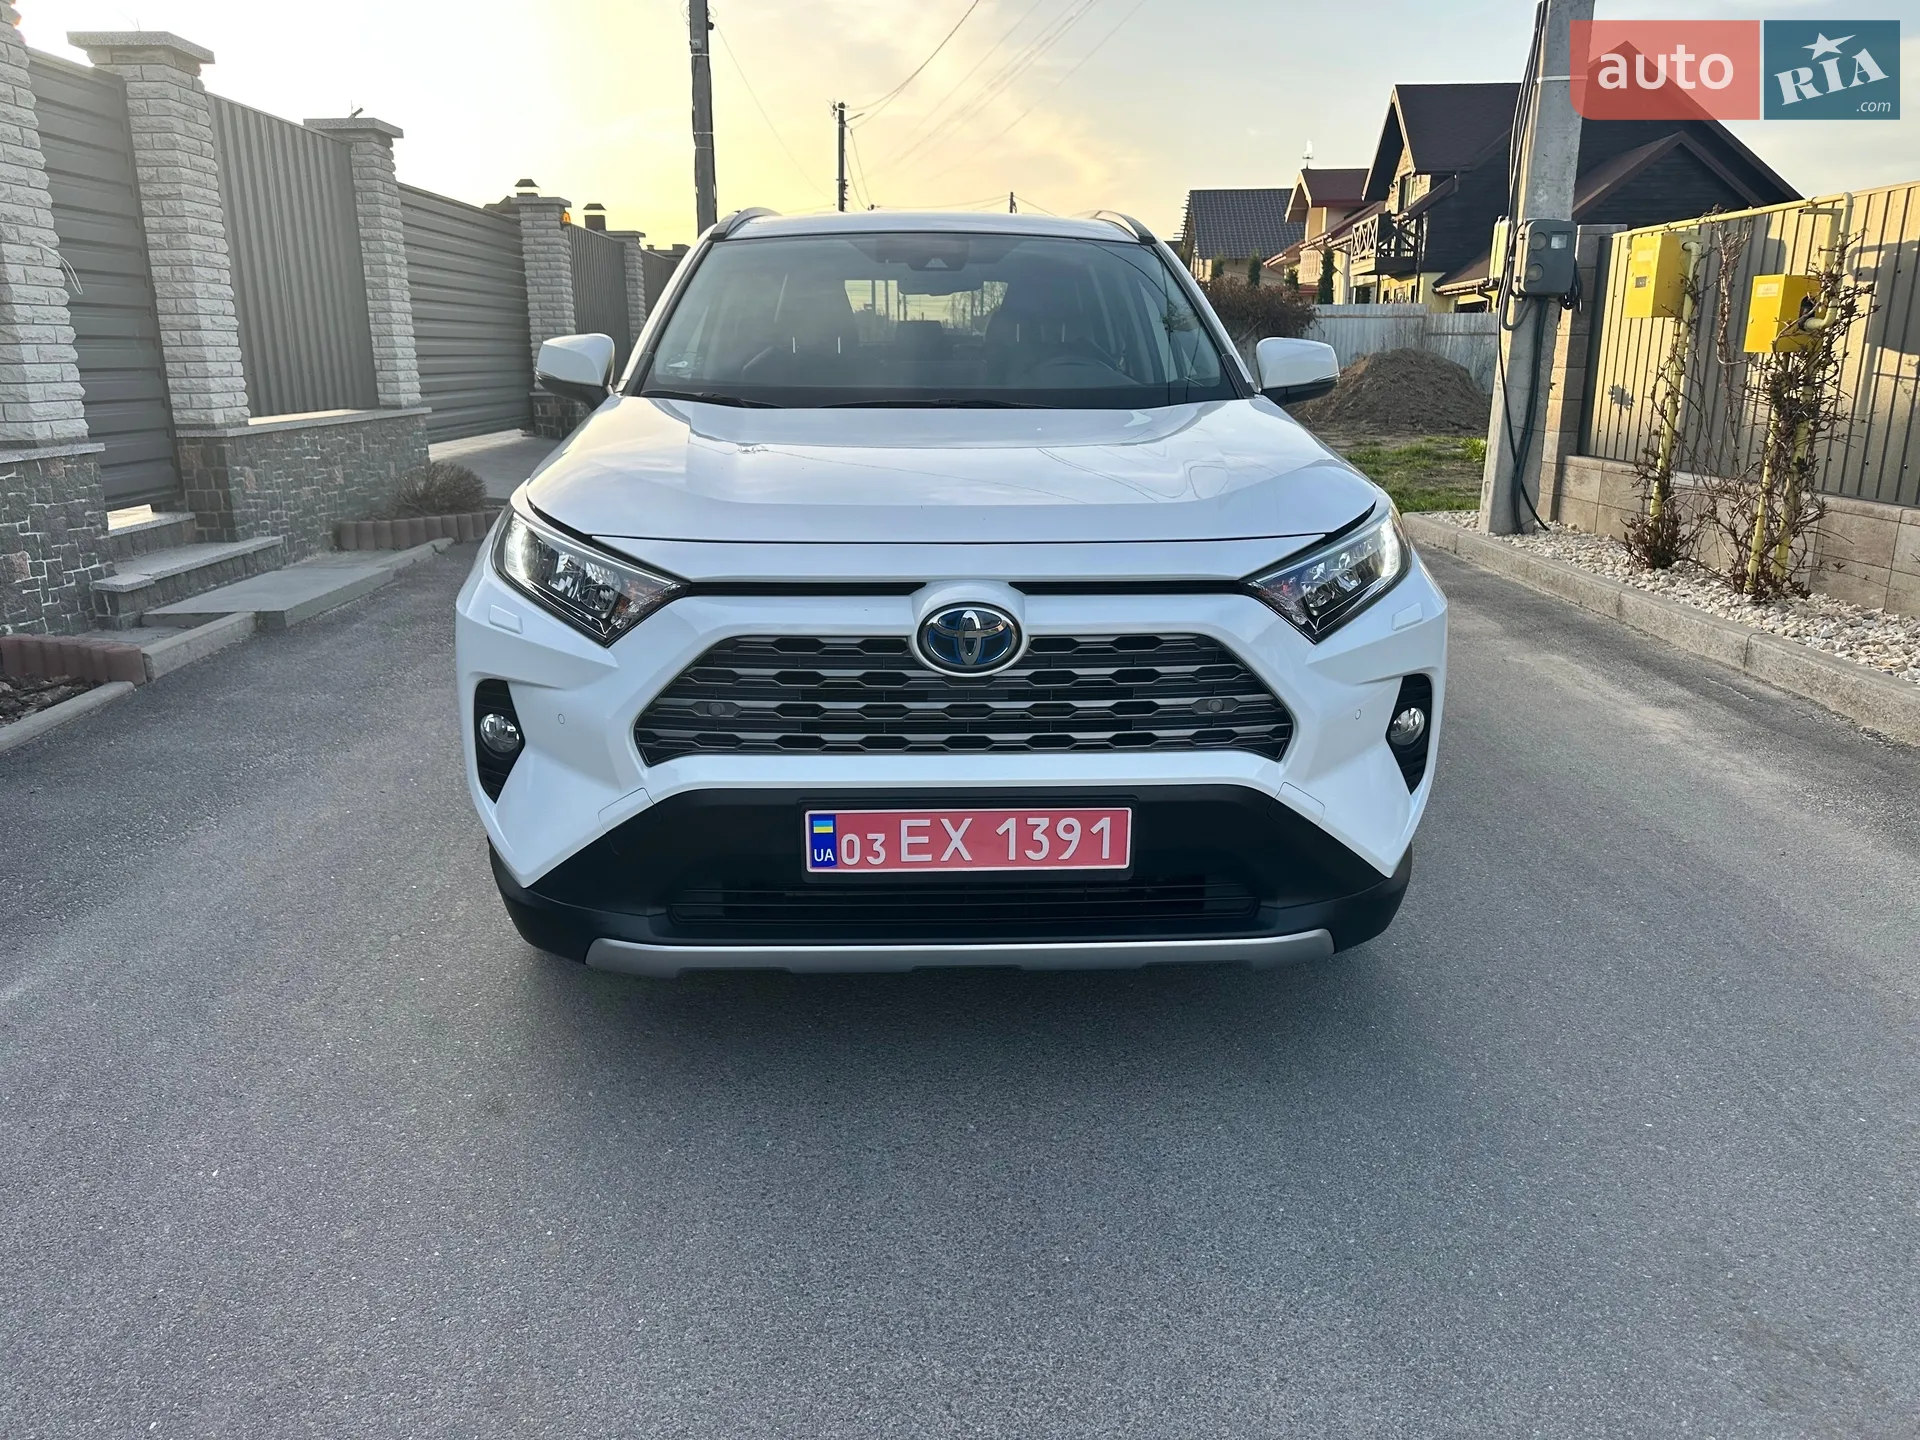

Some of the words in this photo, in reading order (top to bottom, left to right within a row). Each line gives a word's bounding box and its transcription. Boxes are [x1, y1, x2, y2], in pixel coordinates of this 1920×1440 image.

[814, 848, 834, 862] UA
[840, 833, 886, 865] 03
[900, 818, 973, 862] EX
[995, 817, 1111, 860] 1391
